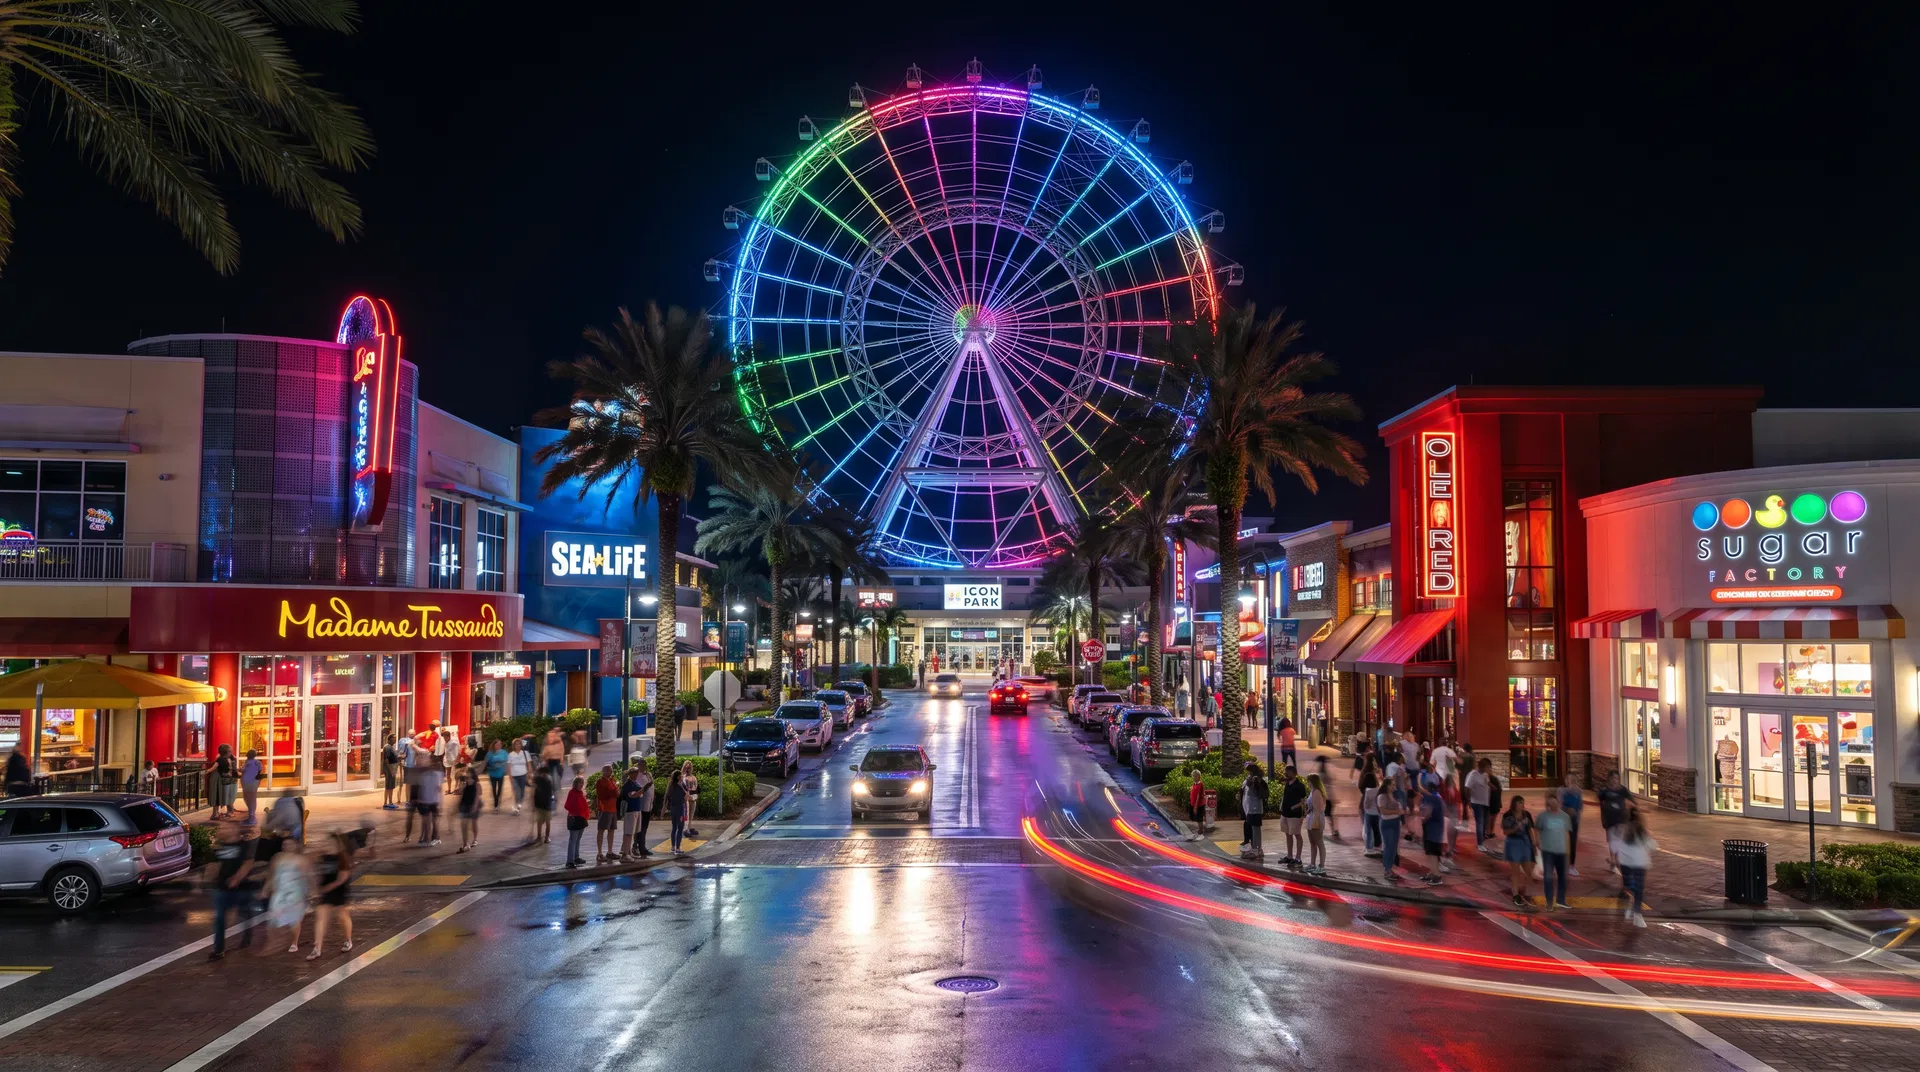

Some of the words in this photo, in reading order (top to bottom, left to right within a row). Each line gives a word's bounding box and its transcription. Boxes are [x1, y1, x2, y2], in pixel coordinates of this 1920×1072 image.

[1426, 438, 1451, 498] OLE
[551, 541, 597, 577] SEA
[1429, 530, 1455, 591] RED
[1697, 530, 1863, 564] sugar
[964, 586, 999, 596] ICON
[1709, 566, 1847, 583] FACTORY
[278, 597, 418, 639] Madame
[408, 603, 504, 639] Tussauds
[964, 597, 999, 607] PARK
